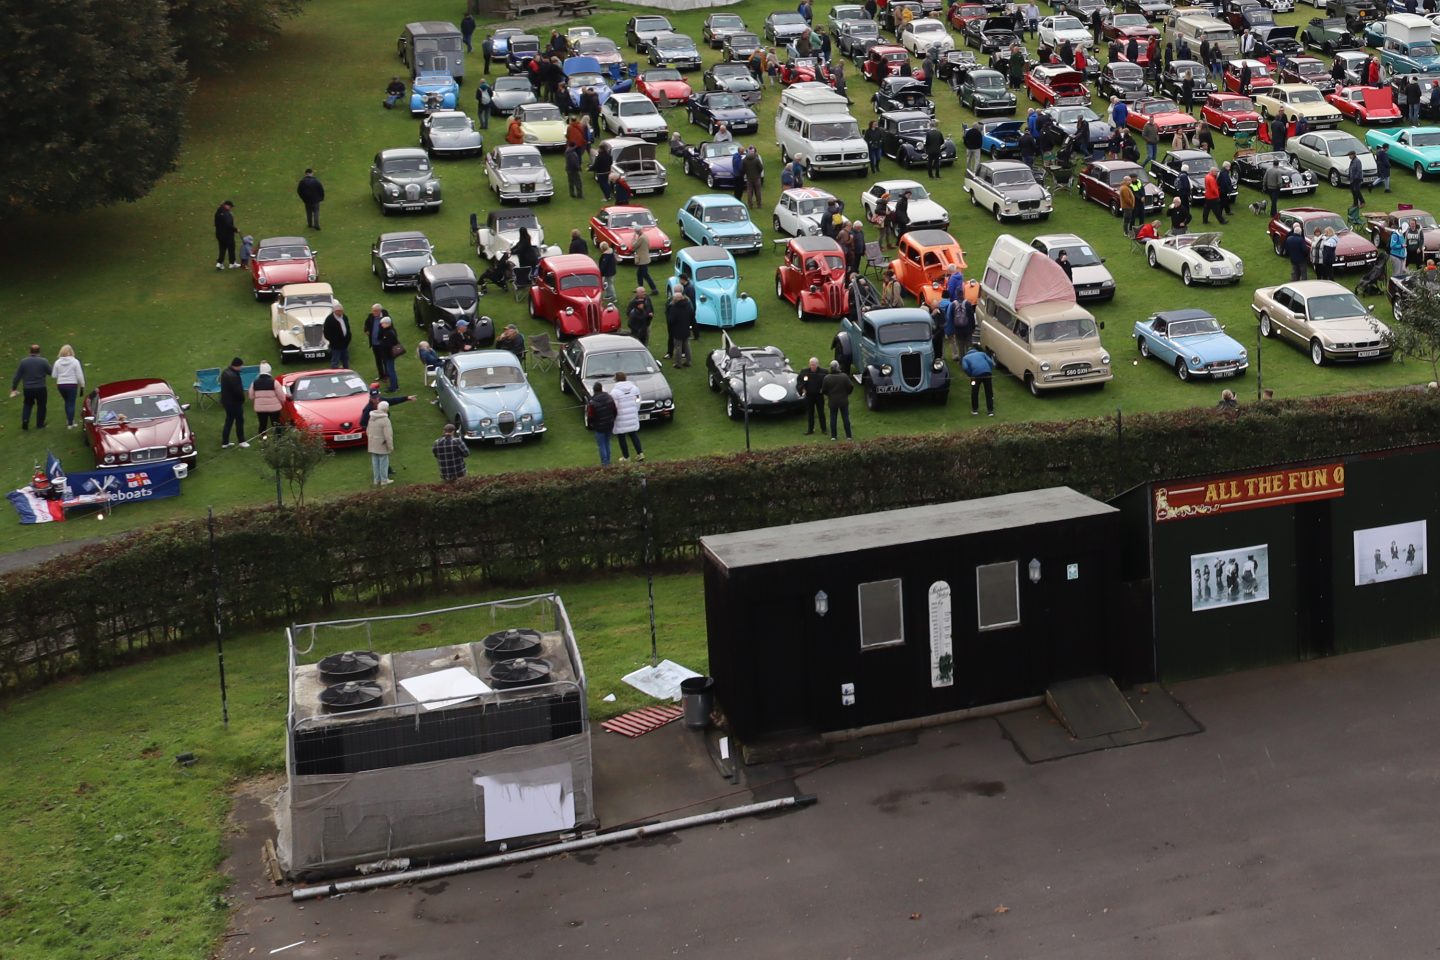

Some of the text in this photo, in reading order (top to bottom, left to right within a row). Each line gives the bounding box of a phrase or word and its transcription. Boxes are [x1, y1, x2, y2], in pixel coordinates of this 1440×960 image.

[1204, 482, 1242, 503] ALL
[1244, 473, 1284, 497] THE
[1288, 468, 1328, 491] FUN
